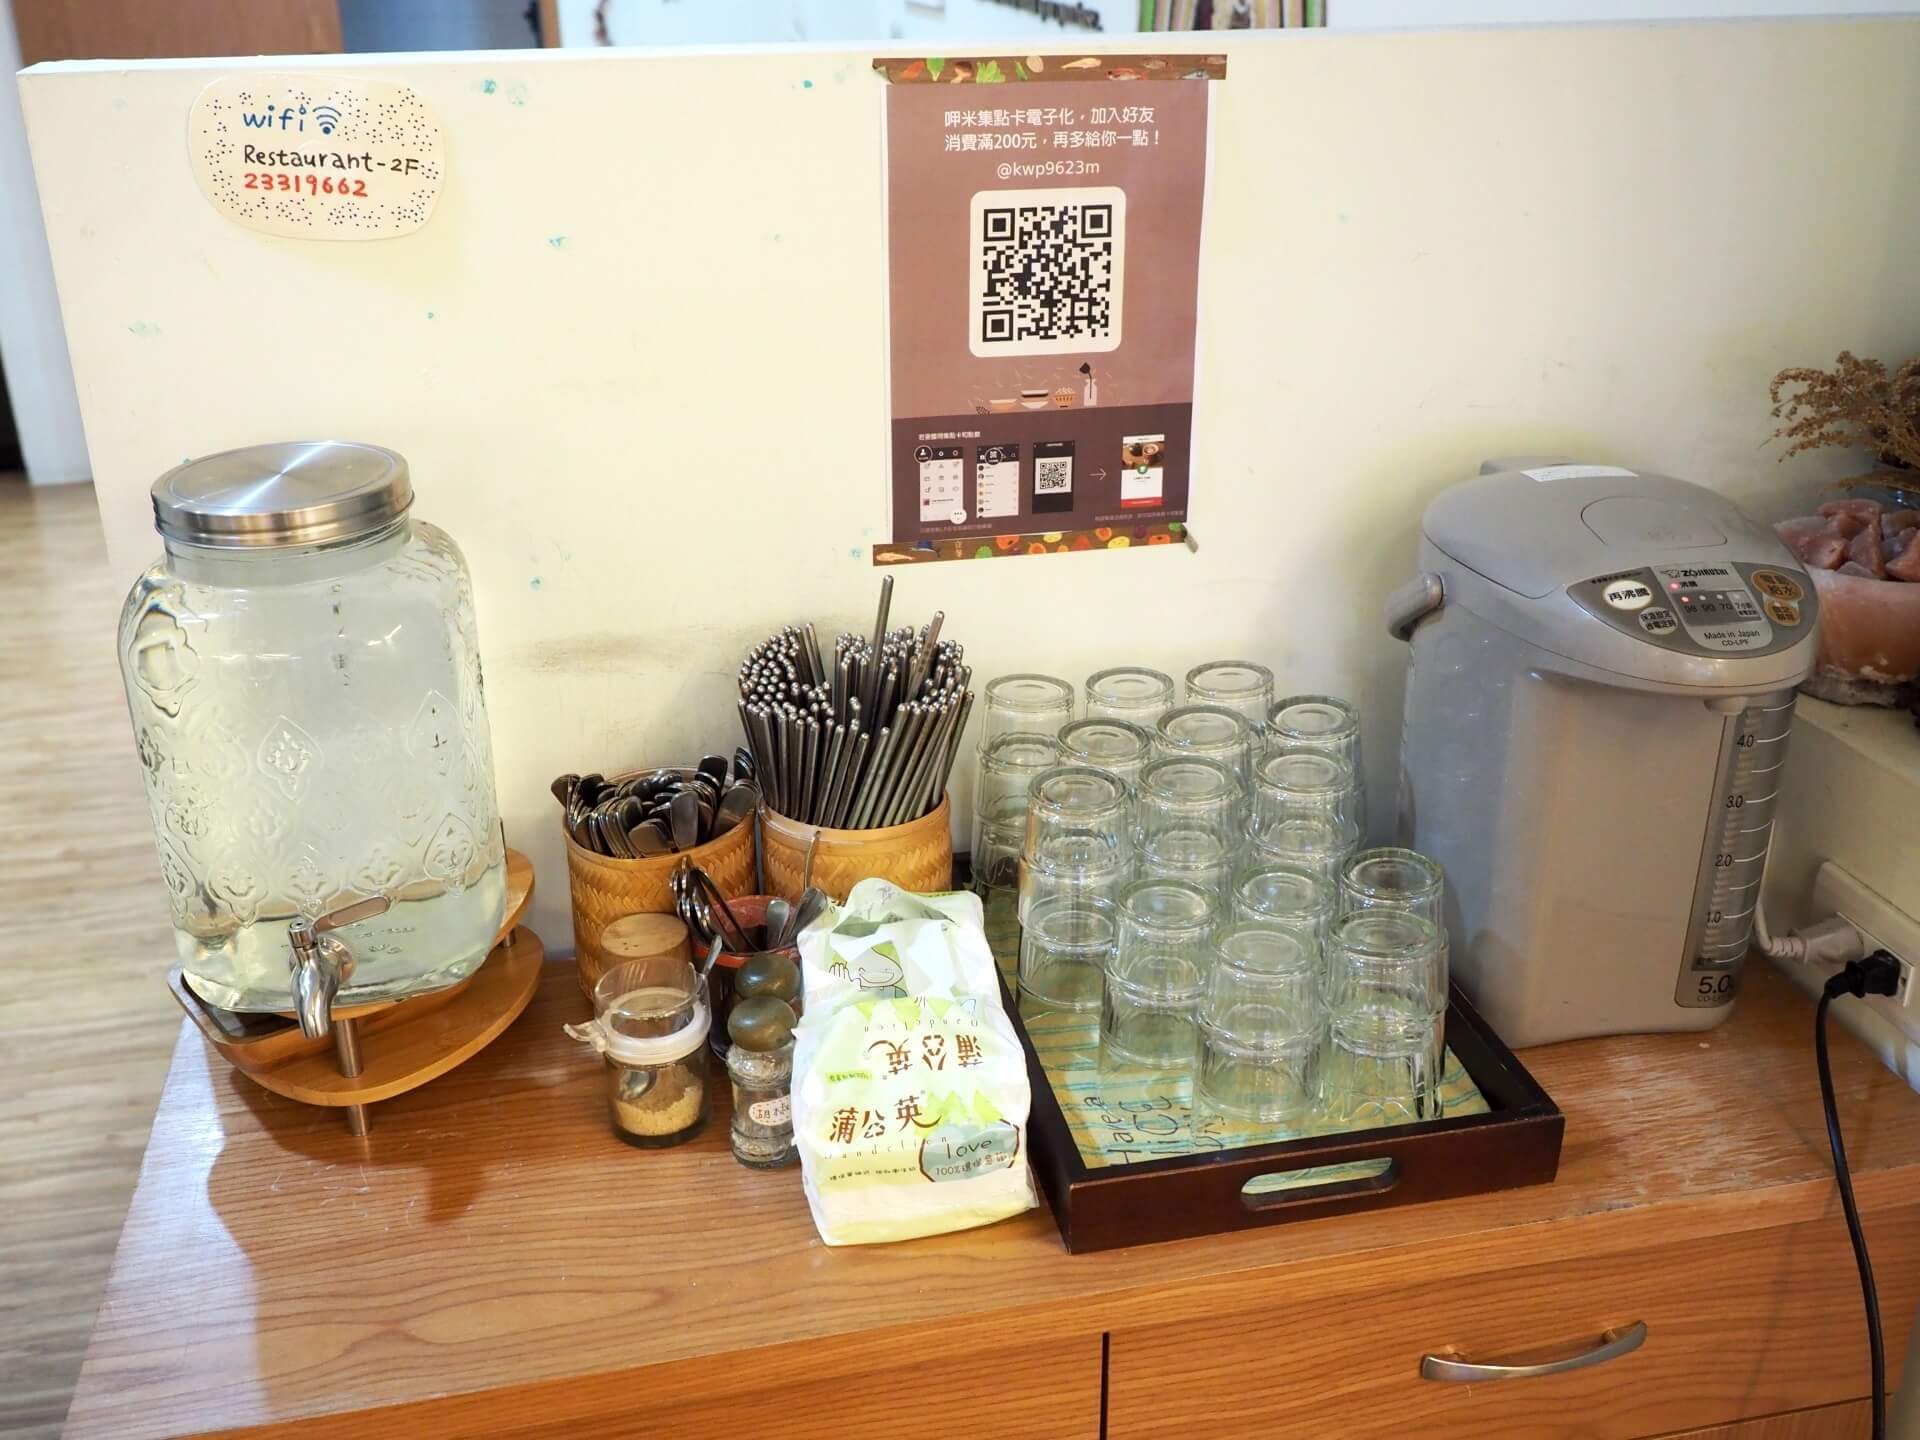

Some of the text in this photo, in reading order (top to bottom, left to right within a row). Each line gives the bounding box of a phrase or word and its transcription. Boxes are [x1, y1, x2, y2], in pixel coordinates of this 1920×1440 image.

[243, 104, 307, 131] wifi
[244, 145, 419, 175] Restaurant-2F
[997, 160, 1100, 179] @kwp9623m
[244, 173, 368, 197] 23319662
[1737, 735, 1754, 748] 4.0
[1726, 795, 1744, 808] 3.0
[1715, 854, 1732, 867] 2.0
[1707, 911, 1721, 924] 1.0
[829, 1095, 942, 1144] 蒲公英
[947, 1140, 992, 1159] love
